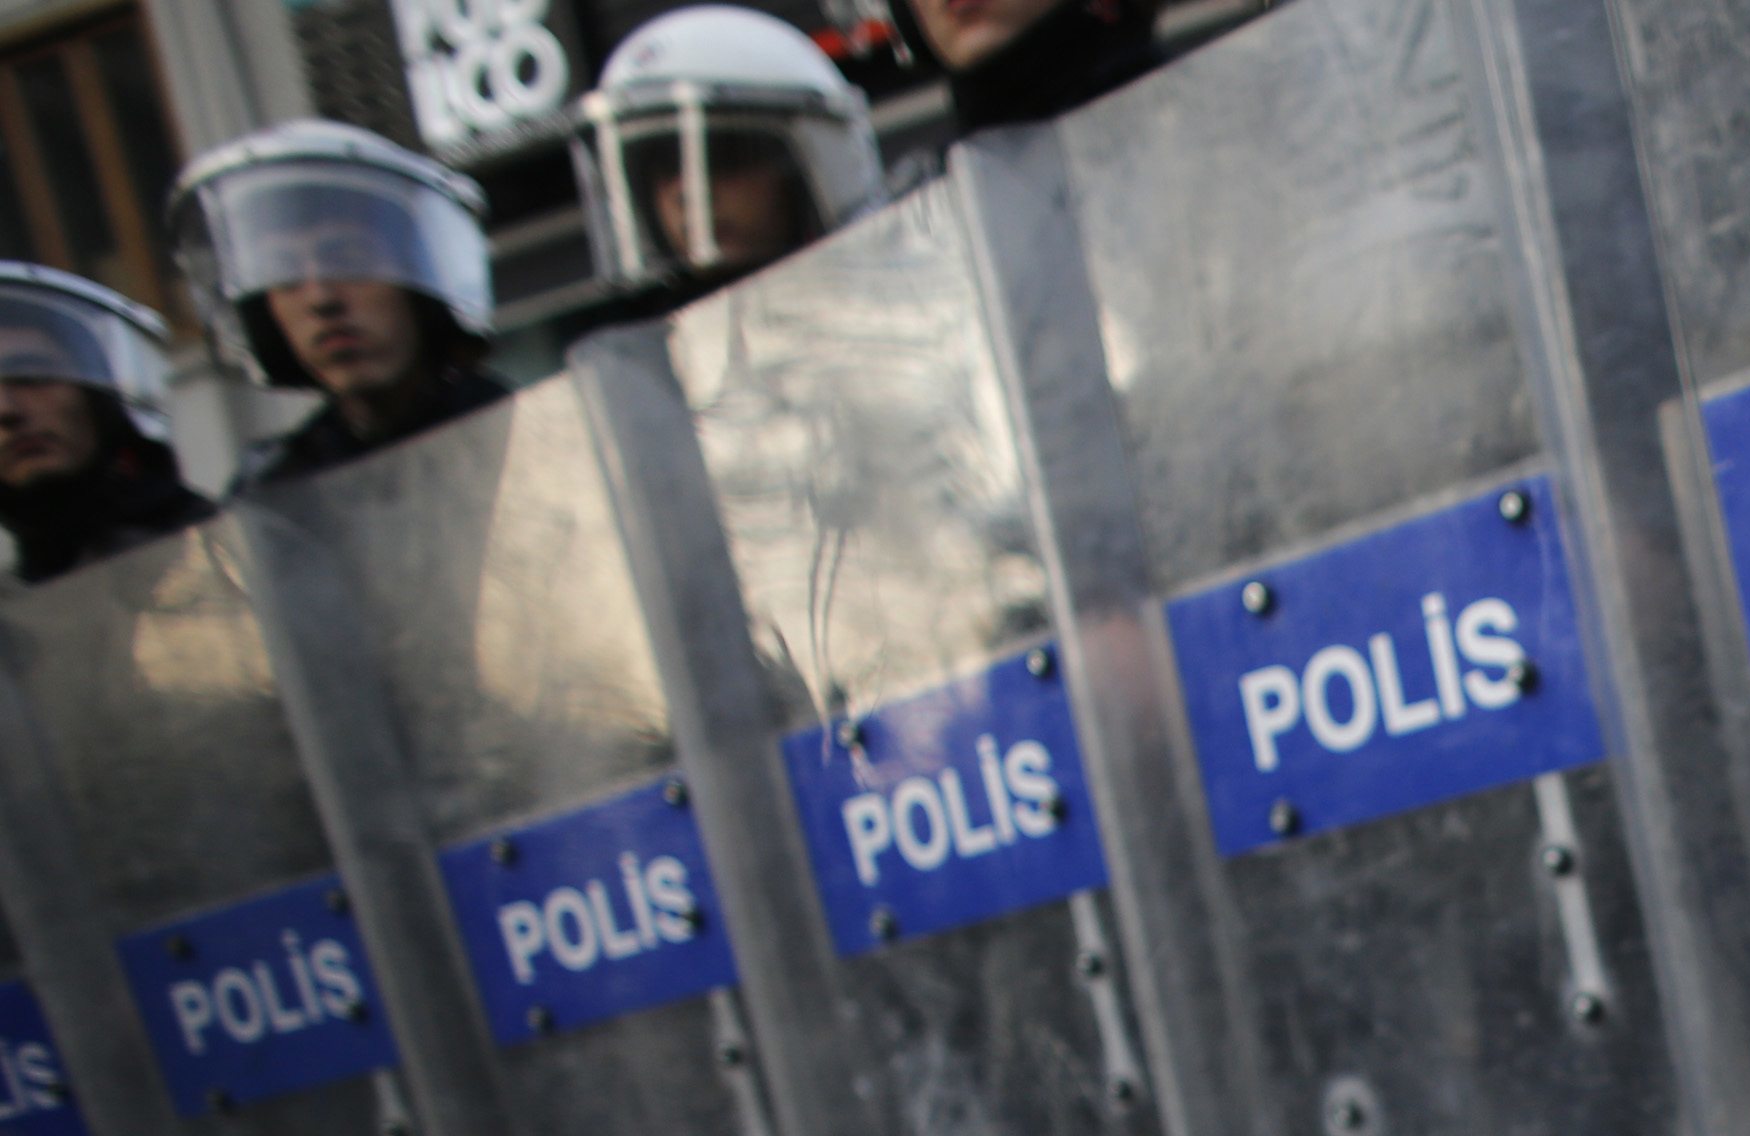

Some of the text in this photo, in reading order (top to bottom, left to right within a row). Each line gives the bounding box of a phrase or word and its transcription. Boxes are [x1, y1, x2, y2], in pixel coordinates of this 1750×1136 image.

[1239, 592, 1526, 773] POLİS
[842, 733, 1060, 887] POLİS
[498, 851, 697, 985] POLİS
[169, 928, 361, 1055] POLİS
